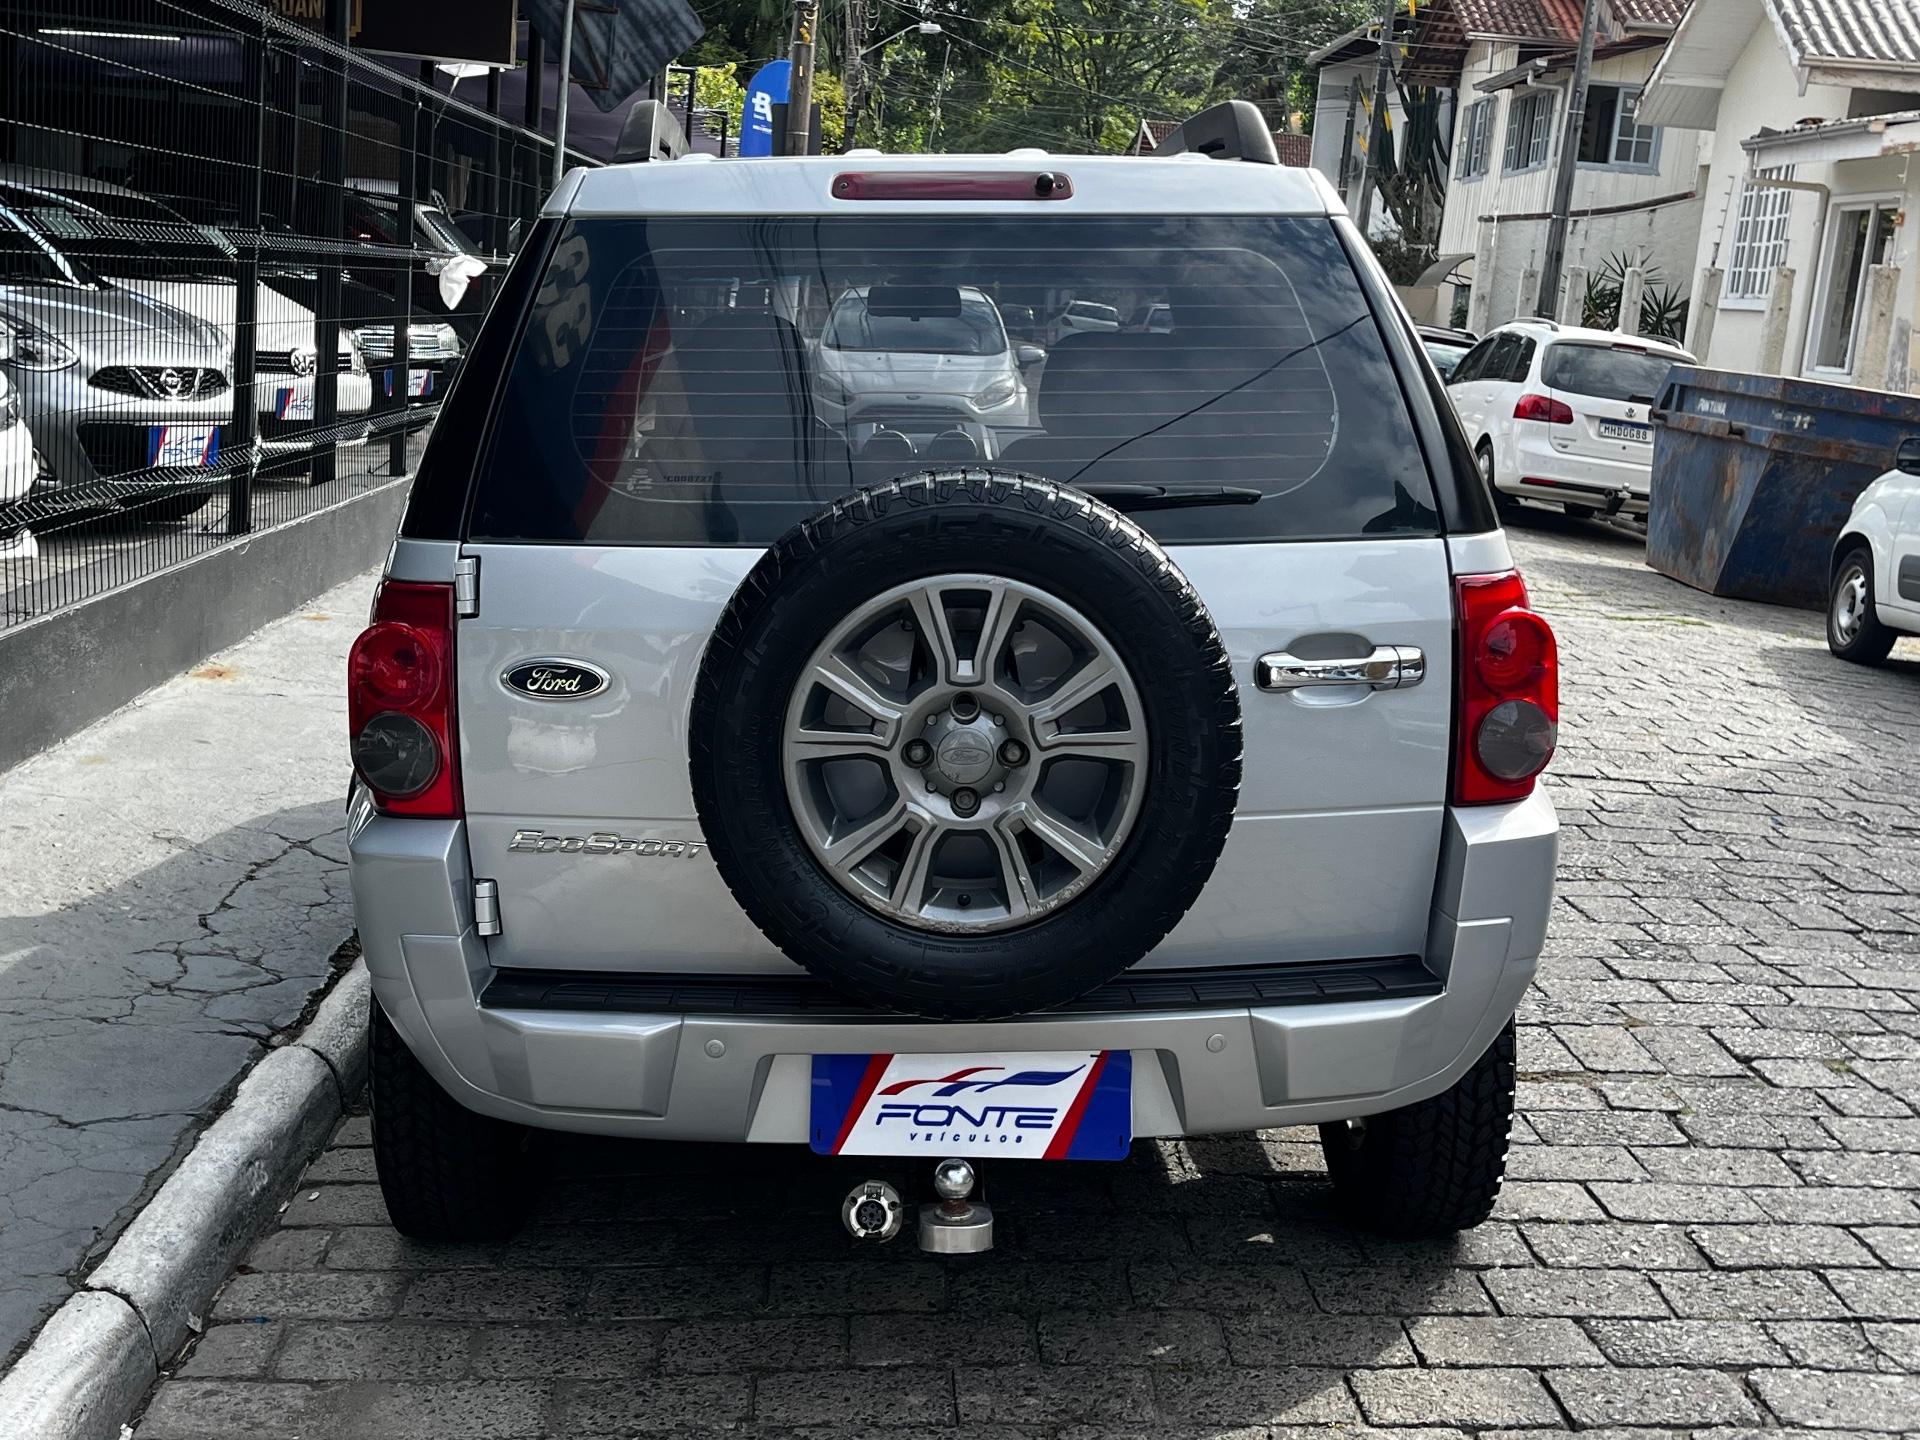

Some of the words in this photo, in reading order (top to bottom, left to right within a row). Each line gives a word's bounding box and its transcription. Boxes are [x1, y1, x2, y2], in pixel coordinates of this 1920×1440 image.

[526, 667, 582, 692] Ford
[875, 1103, 1058, 1129] FONTE
[909, 1131, 1024, 1144] VEÍCULOS
